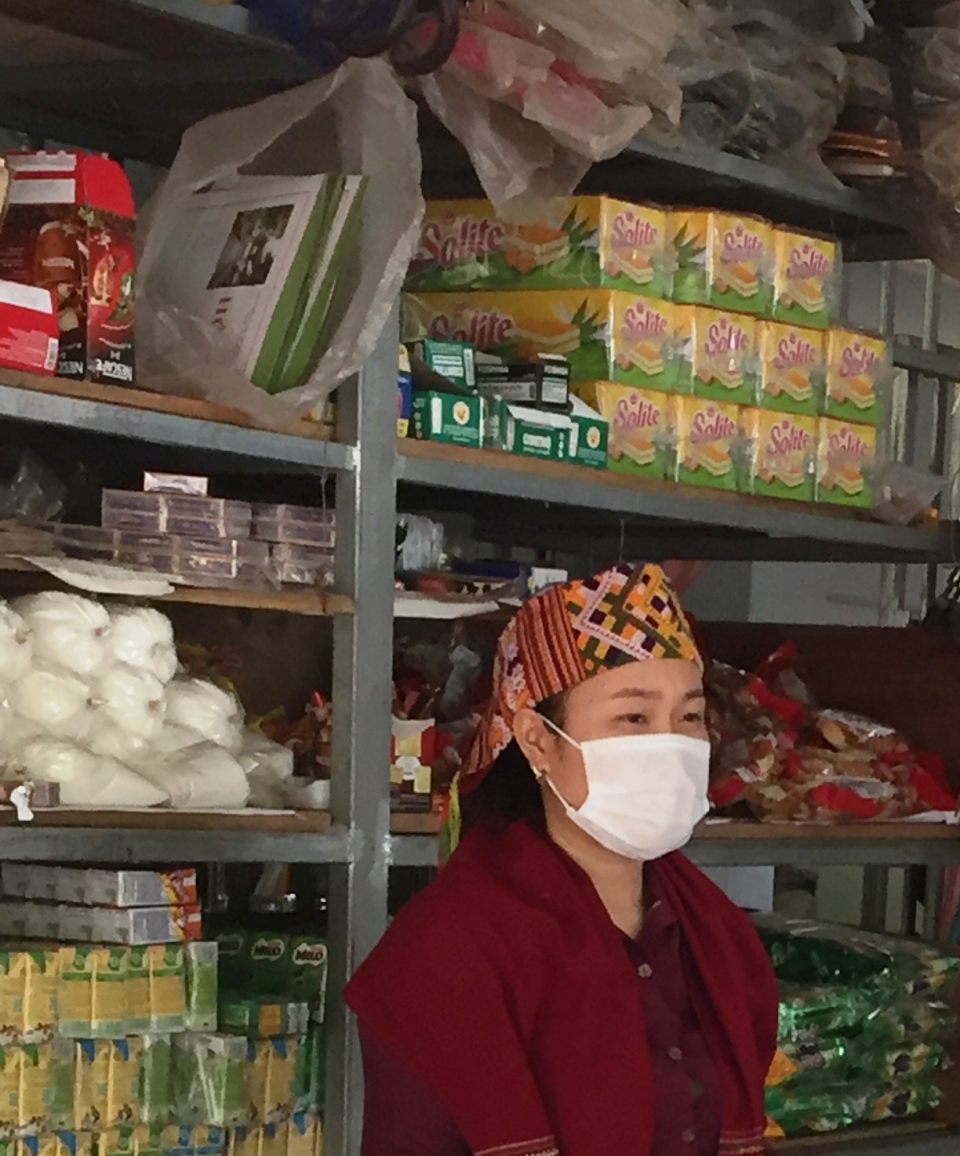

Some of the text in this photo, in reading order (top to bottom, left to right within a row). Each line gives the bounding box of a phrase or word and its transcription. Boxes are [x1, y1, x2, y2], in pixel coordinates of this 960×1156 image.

[421, 221, 502, 265] Solite
[611, 215, 658, 252] Solite
[722, 232, 764, 262] Solite
[786, 250, 832, 282] Solite
[623, 305, 668, 341] Solite
[705, 318, 748, 355] Solite
[776, 334, 816, 372] Solite
[614, 398, 660, 433] Solite
[691, 410, 737, 444] Solite
[767, 420, 809, 457] Solite
[828, 434, 868, 466] Solite
